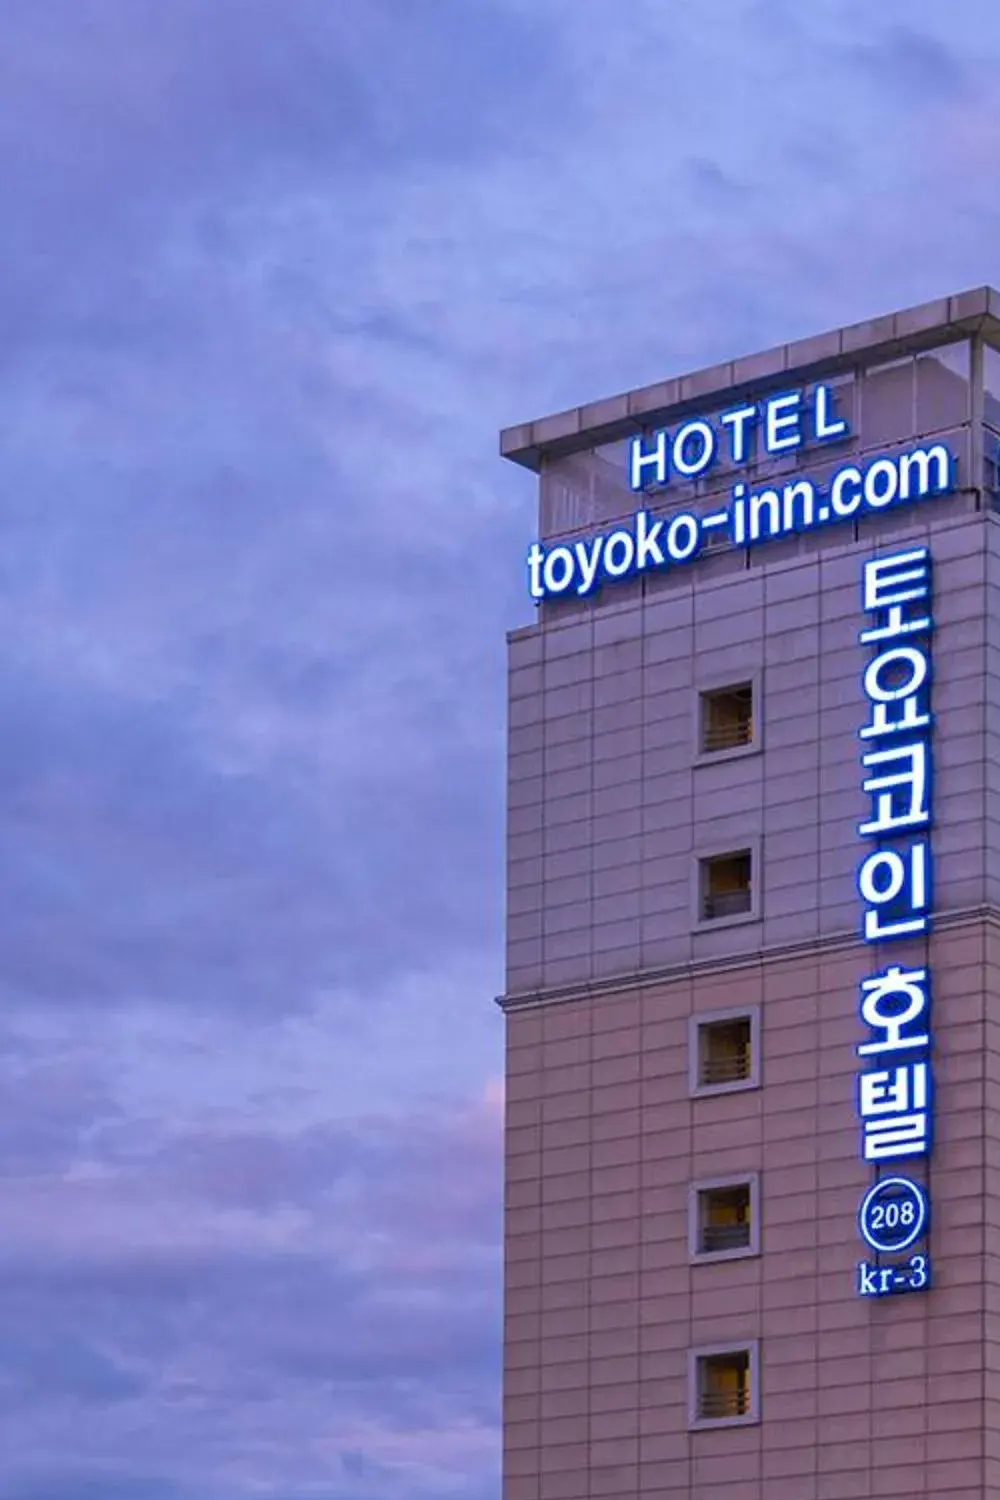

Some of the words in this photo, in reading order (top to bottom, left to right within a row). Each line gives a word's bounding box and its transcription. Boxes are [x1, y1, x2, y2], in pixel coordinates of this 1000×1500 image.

[631, 386, 845, 490] HOTEL
[526, 445, 949, 598] toyoko-inn.com
[858, 549, 929, 939] 토요코인
[857, 966, 929, 1160] 호텔
[859, 1255, 927, 1295] kr-3
[870, 1201, 915, 1230] 208
